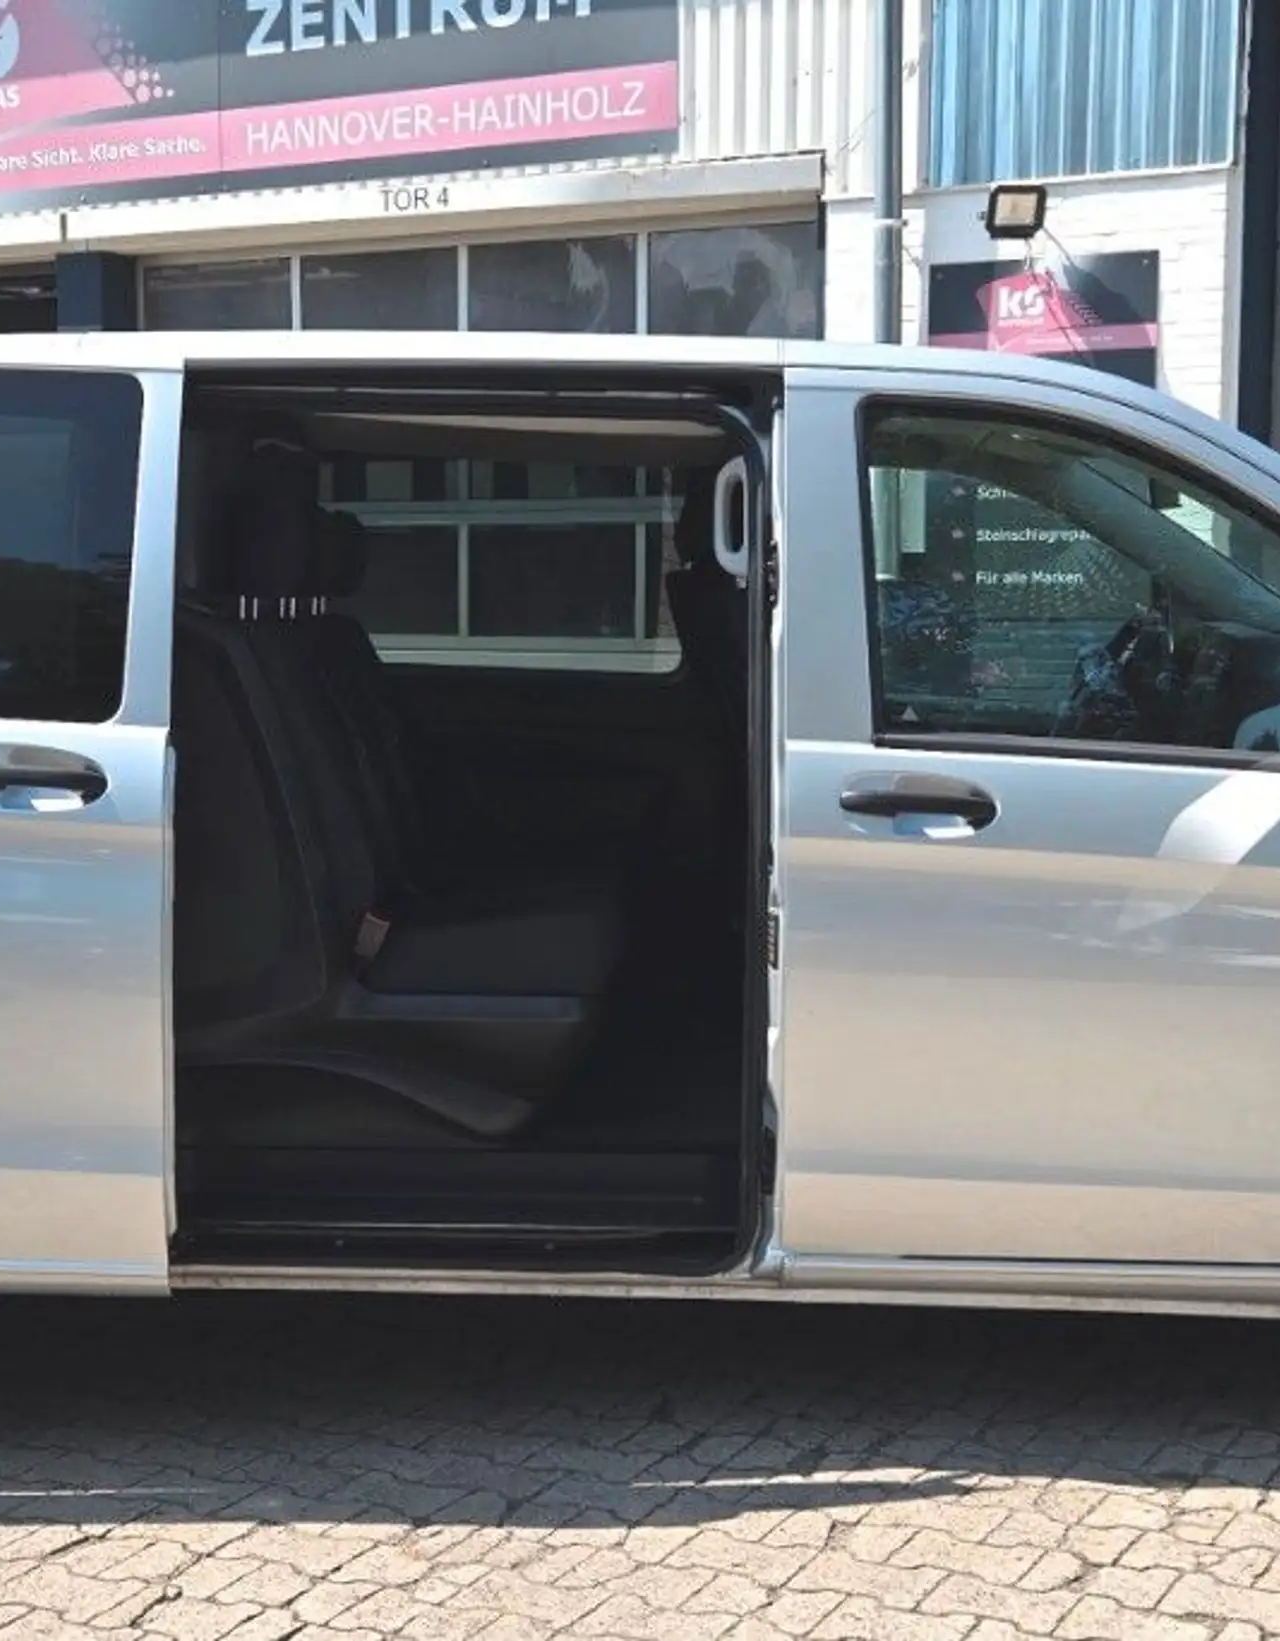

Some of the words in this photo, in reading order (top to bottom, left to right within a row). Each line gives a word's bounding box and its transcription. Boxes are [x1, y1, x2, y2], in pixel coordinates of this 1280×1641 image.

[246, 80, 646, 155] HANNOVER-HAINHOLZ
[32, 147, 83, 170] Sicht.
[89, 142, 139, 164] Klare
[144, 135, 206, 157] Sache.
[379, 187, 430, 212] TOR
[436, 186, 449, 208] 4
[976, 569, 999, 585] Für
[1002, 570, 1028, 585] alle
[1031, 568, 1083, 586] Marken
